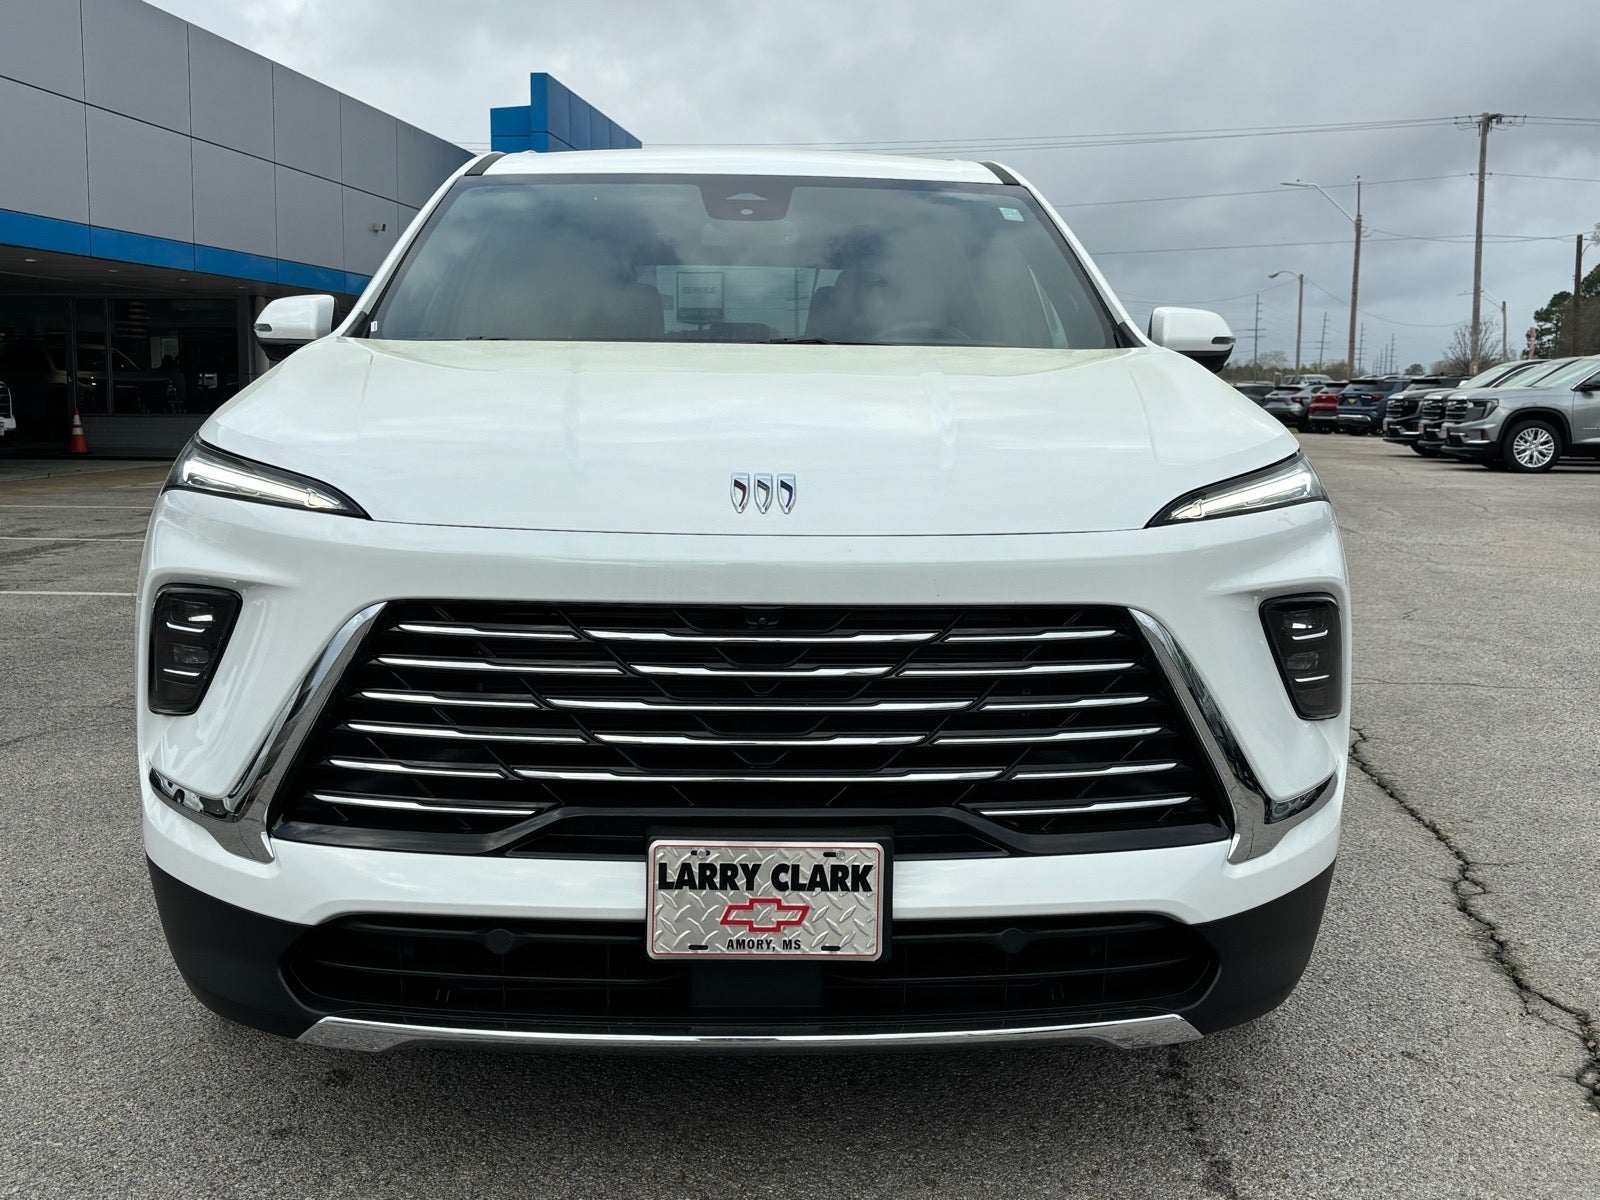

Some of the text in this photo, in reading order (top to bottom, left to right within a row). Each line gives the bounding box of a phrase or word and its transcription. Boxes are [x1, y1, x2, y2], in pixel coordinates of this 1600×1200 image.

[658, 862, 873, 892] LARRY CLARK
[727, 939, 801, 952] AMORY, MS
